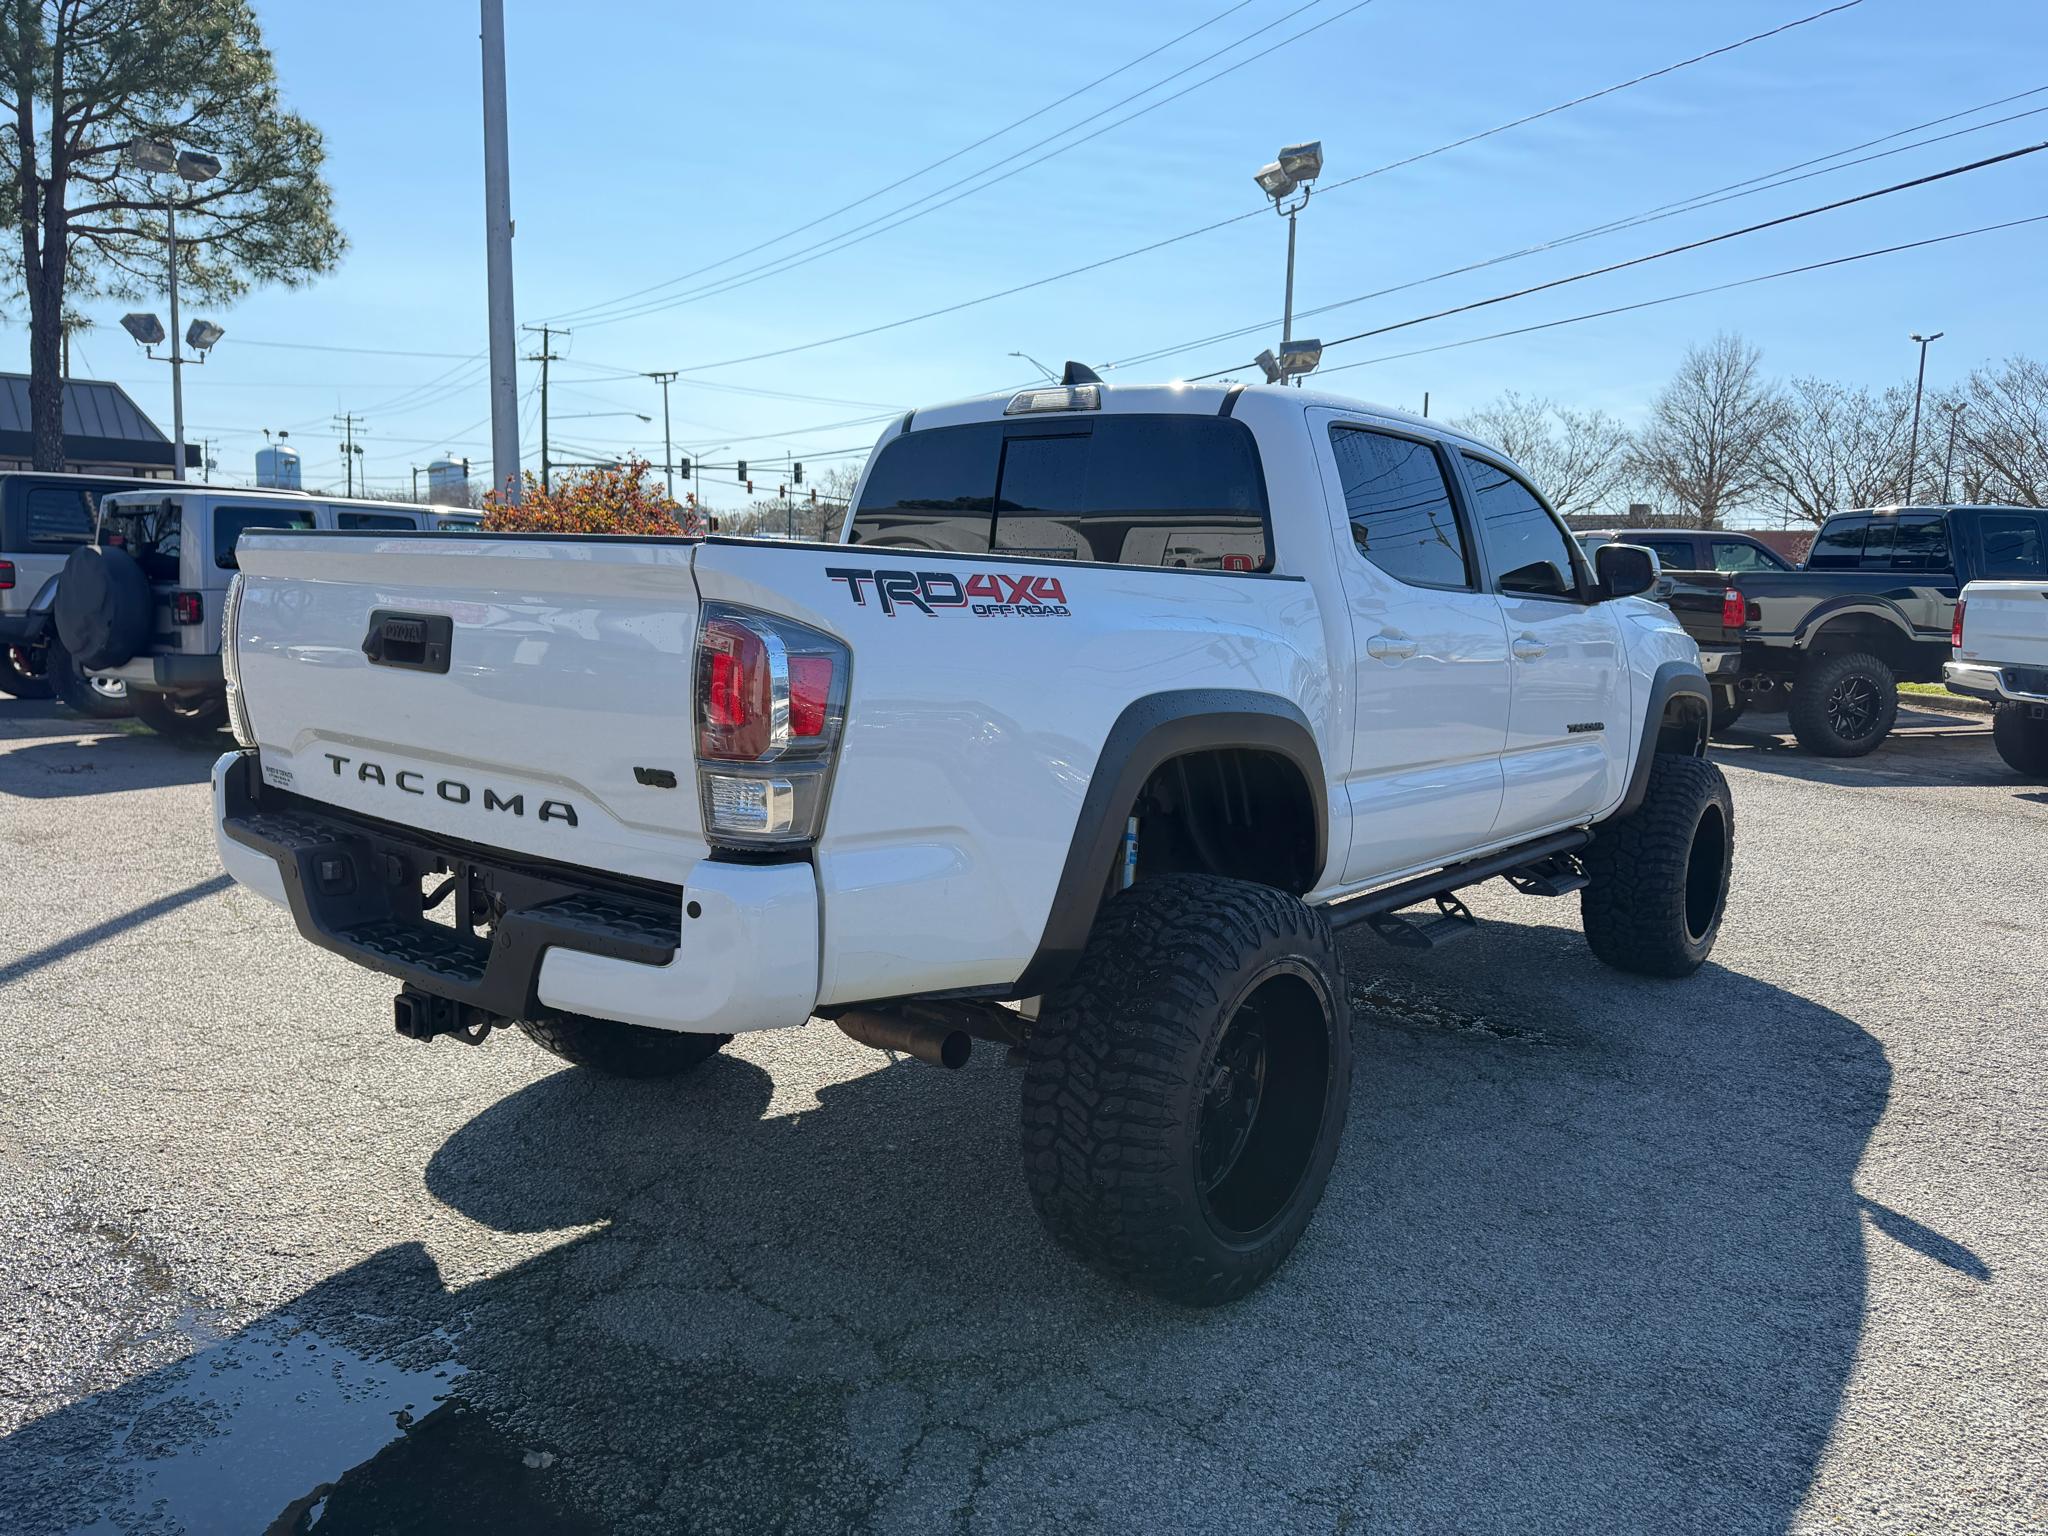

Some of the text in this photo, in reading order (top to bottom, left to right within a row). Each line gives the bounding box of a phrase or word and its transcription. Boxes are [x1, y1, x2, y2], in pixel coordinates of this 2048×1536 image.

[825, 568, 968, 617] TRD
[325, 753, 579, 827] TACOMA
[632, 766, 678, 789] V6
